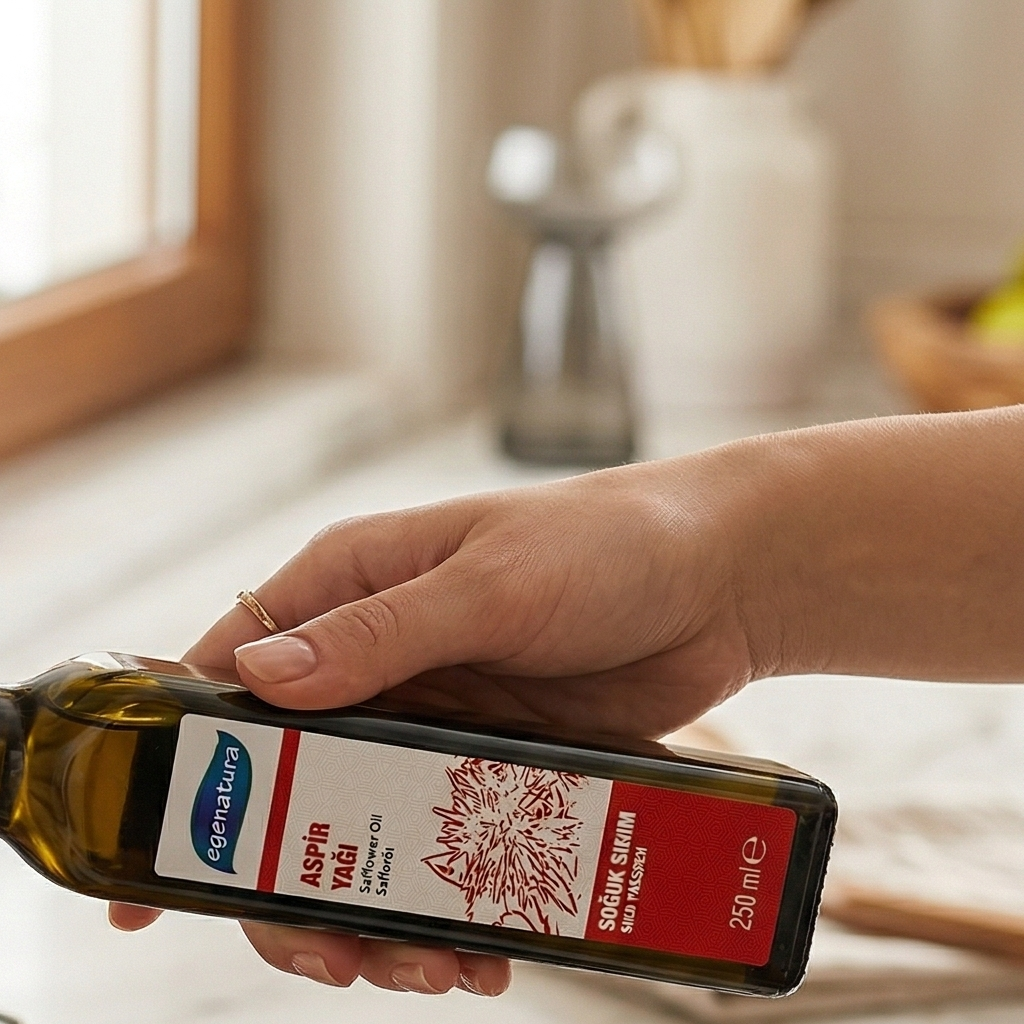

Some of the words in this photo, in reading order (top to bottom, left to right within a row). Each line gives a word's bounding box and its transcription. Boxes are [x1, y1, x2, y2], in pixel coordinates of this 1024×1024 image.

[207, 747, 240, 862] egenatura
[300, 822, 330, 887] ASPİR
[610, 810, 637, 866] SIKIM
[329, 843, 359, 890] YAĞI
[739, 866, 761, 891] ml
[597, 869, 627, 932] SOĞUK
[730, 895, 757, 931] 250
